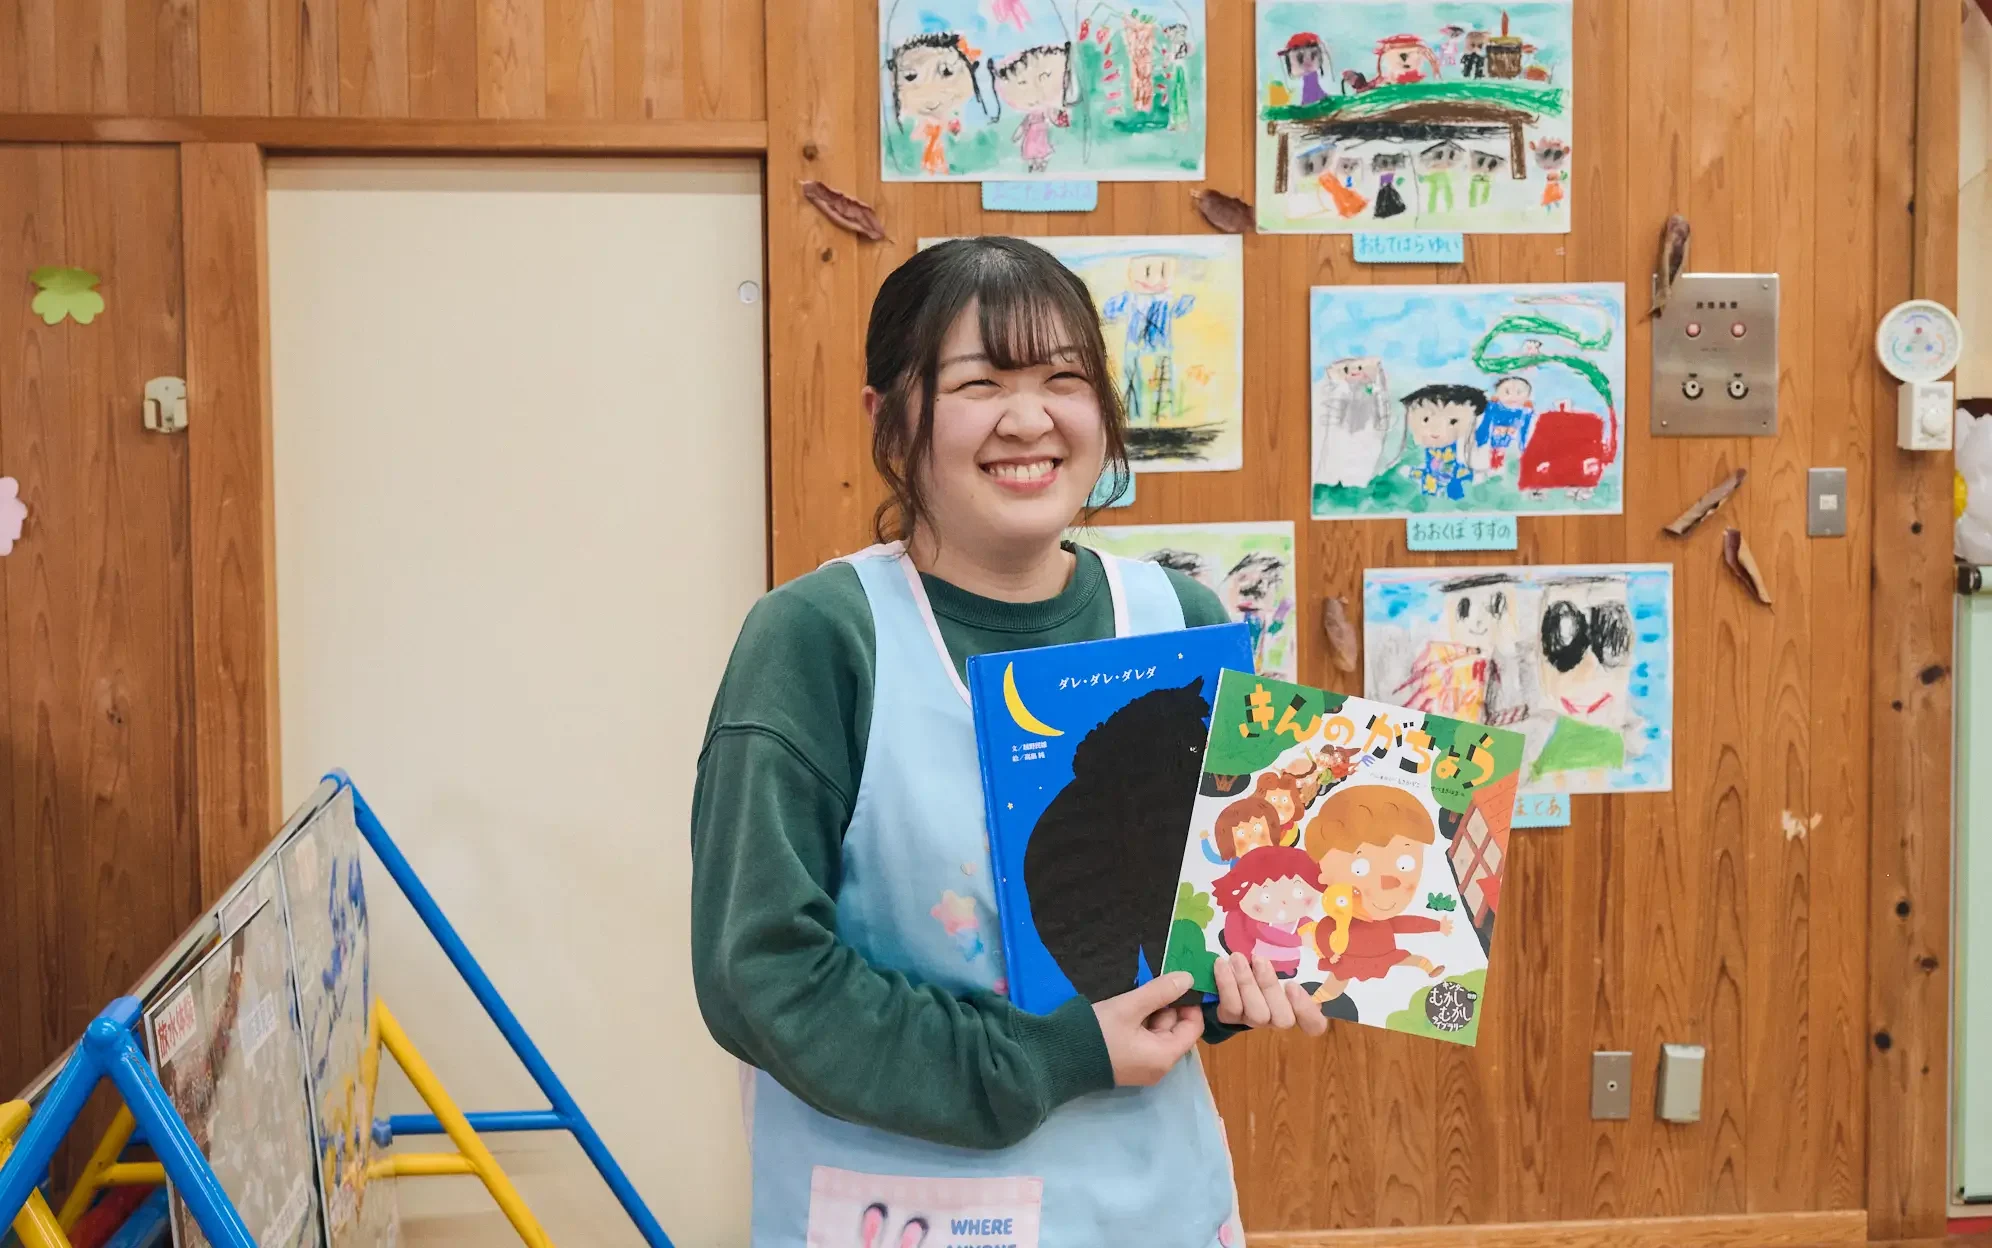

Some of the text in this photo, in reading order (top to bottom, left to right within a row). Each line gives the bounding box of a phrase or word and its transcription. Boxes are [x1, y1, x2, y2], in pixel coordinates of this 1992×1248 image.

[1413, 516, 1467, 541] おおくぼ
[1059, 666, 1156, 691] ダレ・ダレ・ダレダ
[1429, 987, 1464, 1007] むかし
[1438, 1006, 1472, 1023] むかし
[950, 1217, 1013, 1236] WHERE
